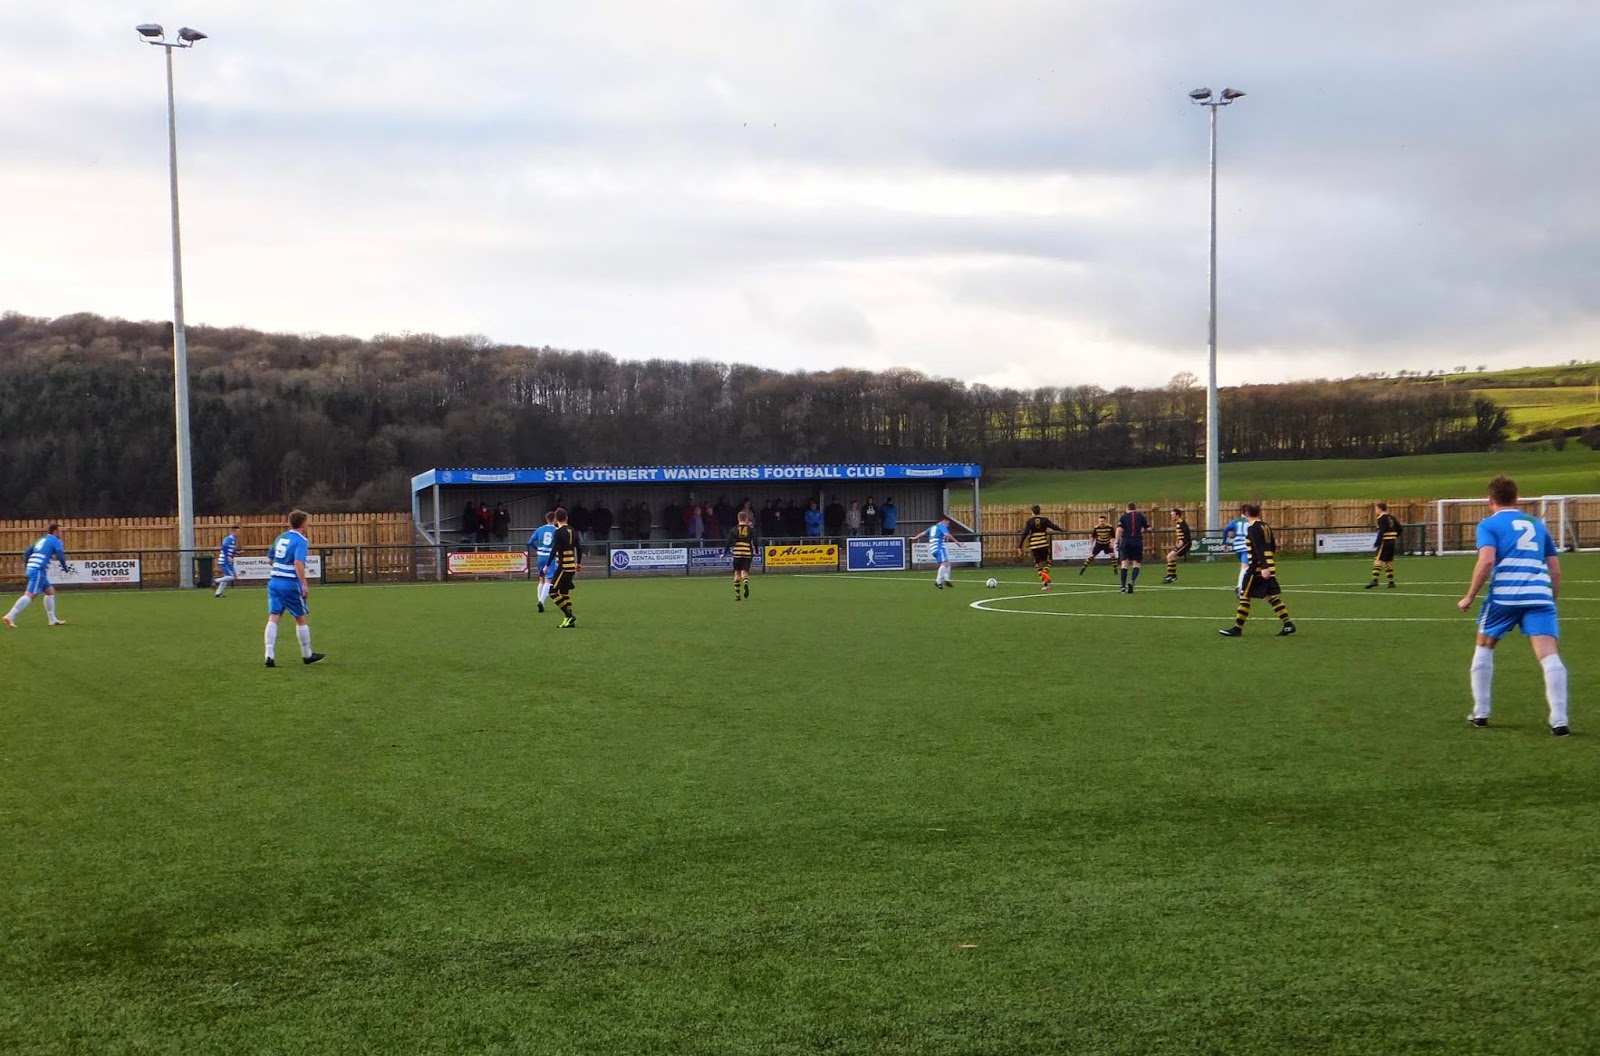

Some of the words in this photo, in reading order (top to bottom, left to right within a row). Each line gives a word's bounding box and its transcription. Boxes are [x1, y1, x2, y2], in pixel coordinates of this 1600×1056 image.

[544, 470, 567, 482] ST.
[572, 469, 658, 481] CUTHBERT
[663, 468, 759, 480] WANDERERS
[764, 467, 841, 479] FOOTBALL
[846, 466, 885, 478] CLUB
[738, 526, 748, 537] 14
[1512, 519, 1538, 551] 2
[275, 538, 290, 559] 5
[780, 547, 823, 556] Alinda
[84, 561, 135, 569] ROGERSON
[613, 554, 629, 566] KDS
